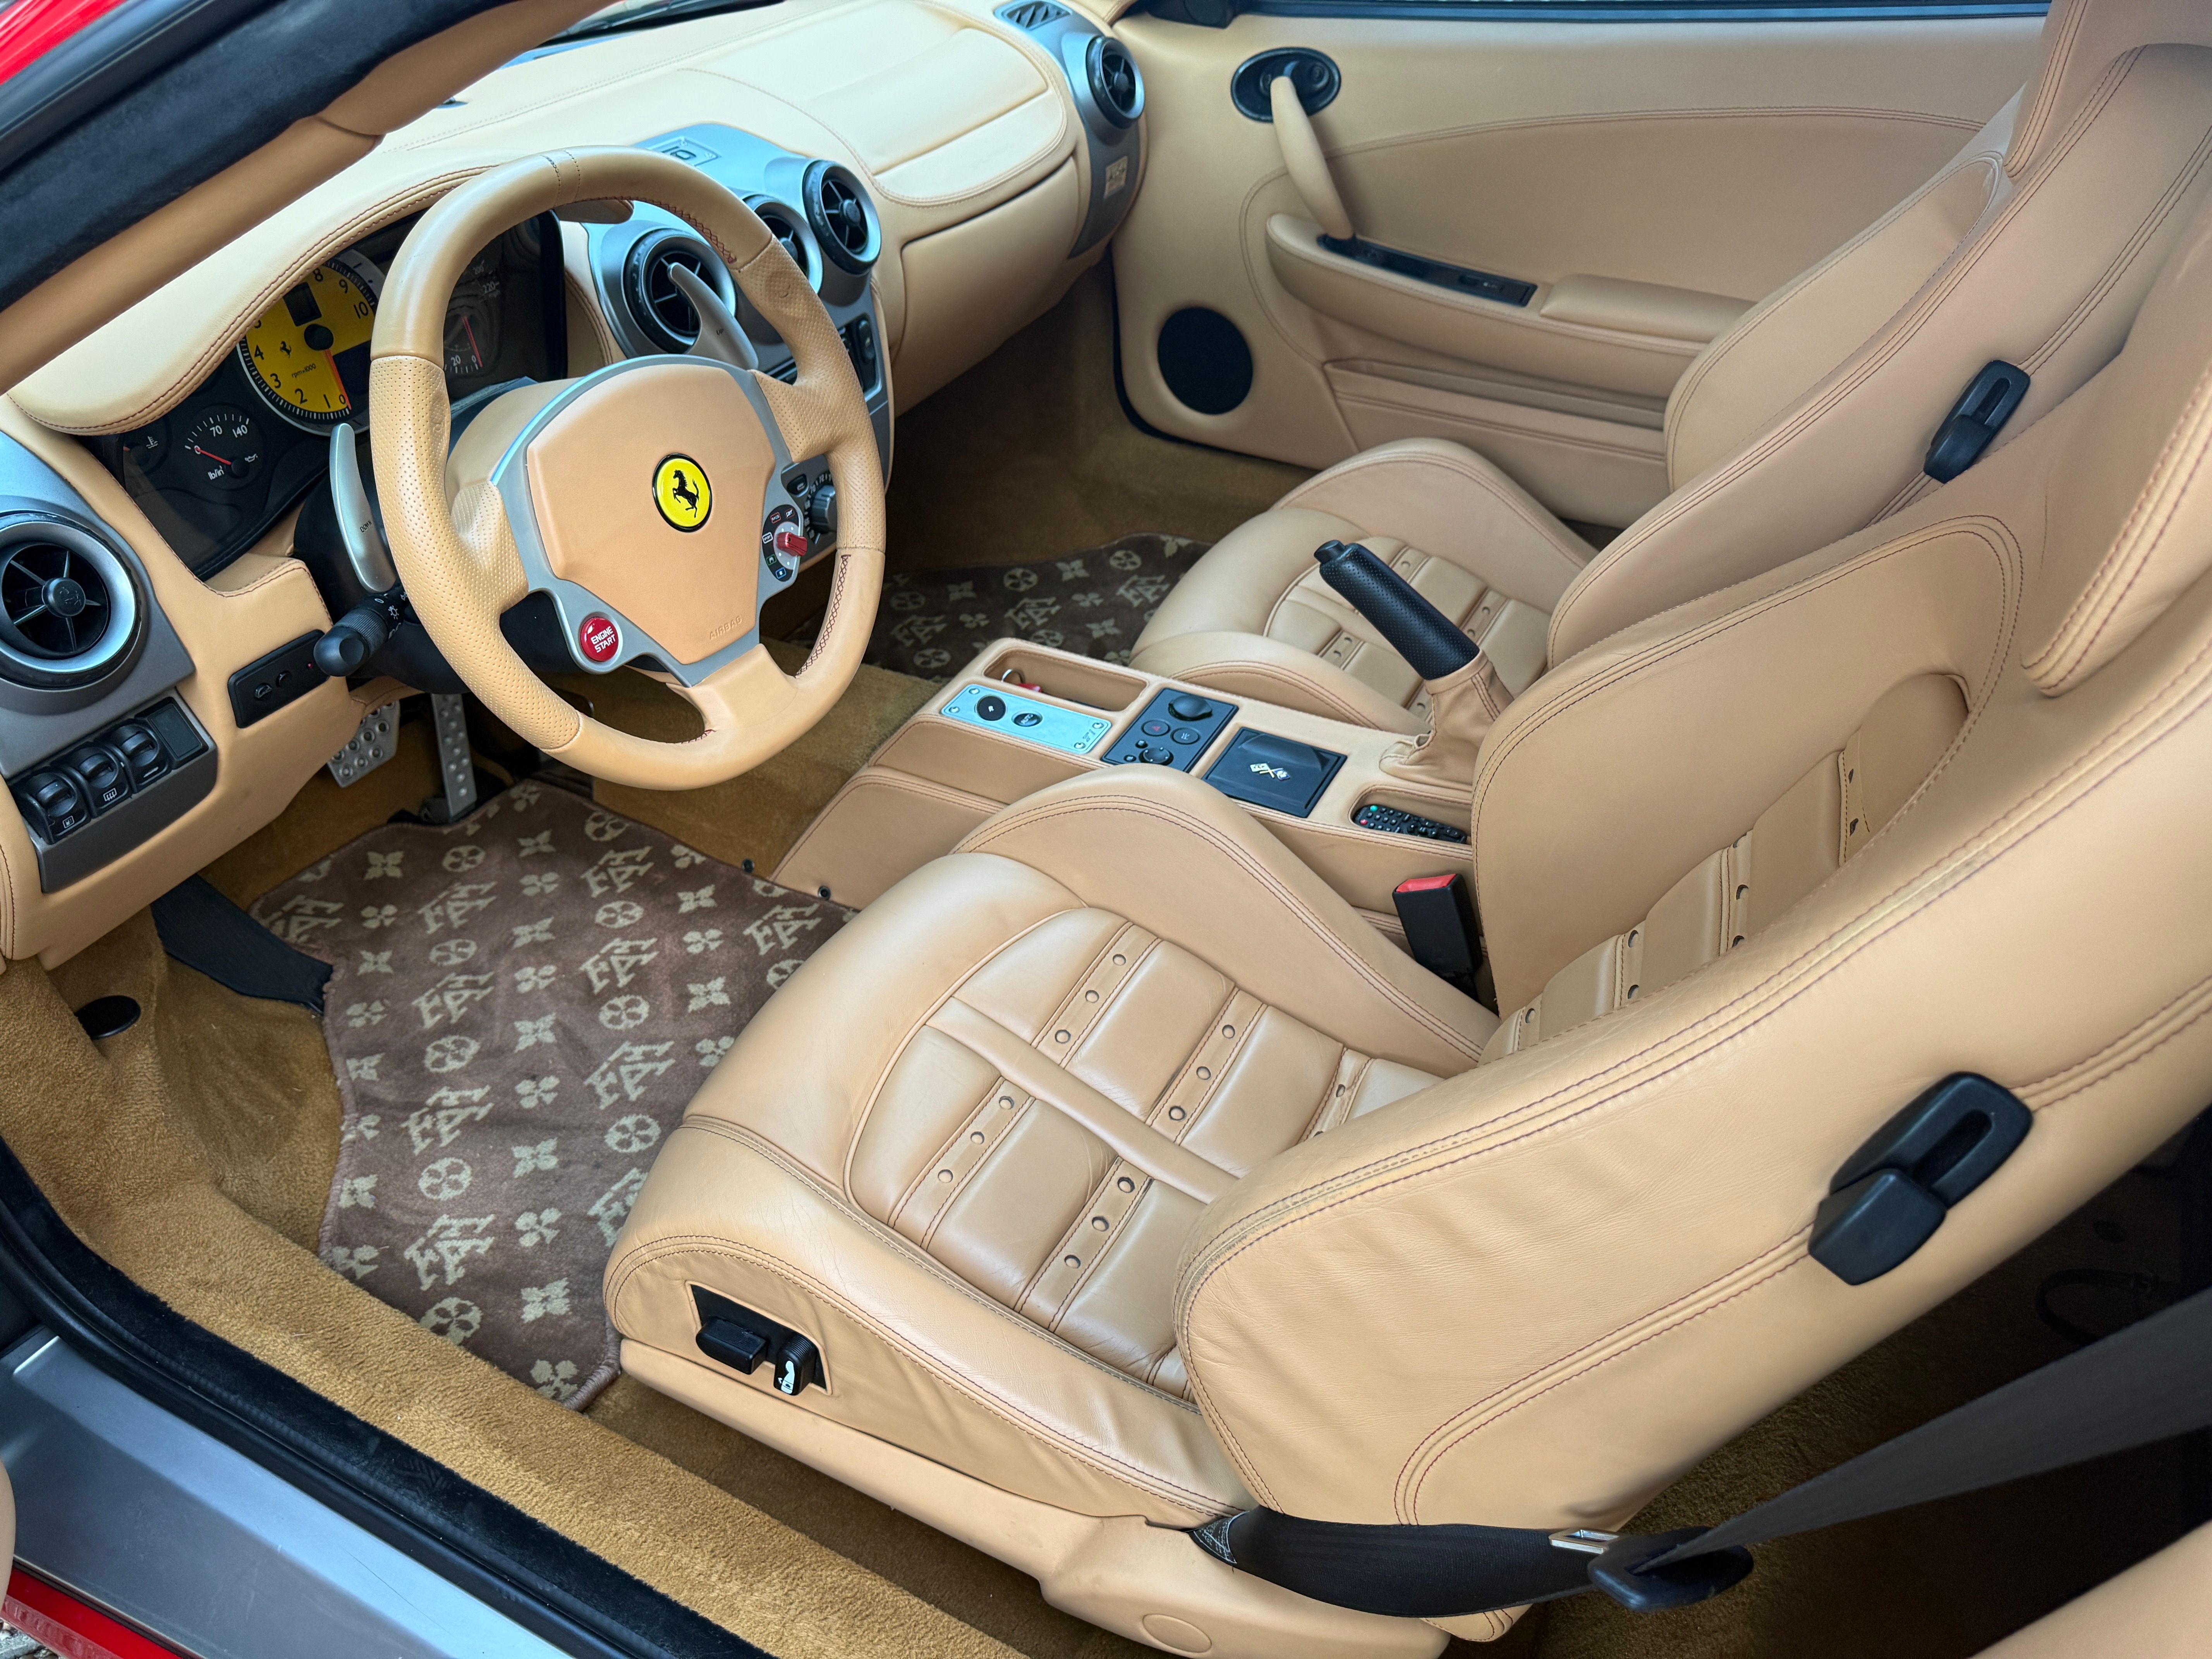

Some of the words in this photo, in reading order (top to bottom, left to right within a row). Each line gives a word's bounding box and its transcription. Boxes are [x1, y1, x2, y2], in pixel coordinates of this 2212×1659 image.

[313, 268, 324, 282] 8
[339, 280, 348, 294] 9
[354, 301, 368, 319] 10
[254, 345, 264, 360] 4
[451, 355, 461, 366] 20
[270, 373, 281, 388] 3
[295, 388, 307, 404] 2
[323, 394, 331, 409] 1
[339, 394, 347, 404] 0
[210, 425, 222, 437] 70
[232, 424, 248, 438] 140
[360, 520, 372, 532] DOWN
[591, 626, 613, 644] ENGINE
[710, 615, 742, 640] AIRBAG
[594, 634, 615, 653] START
